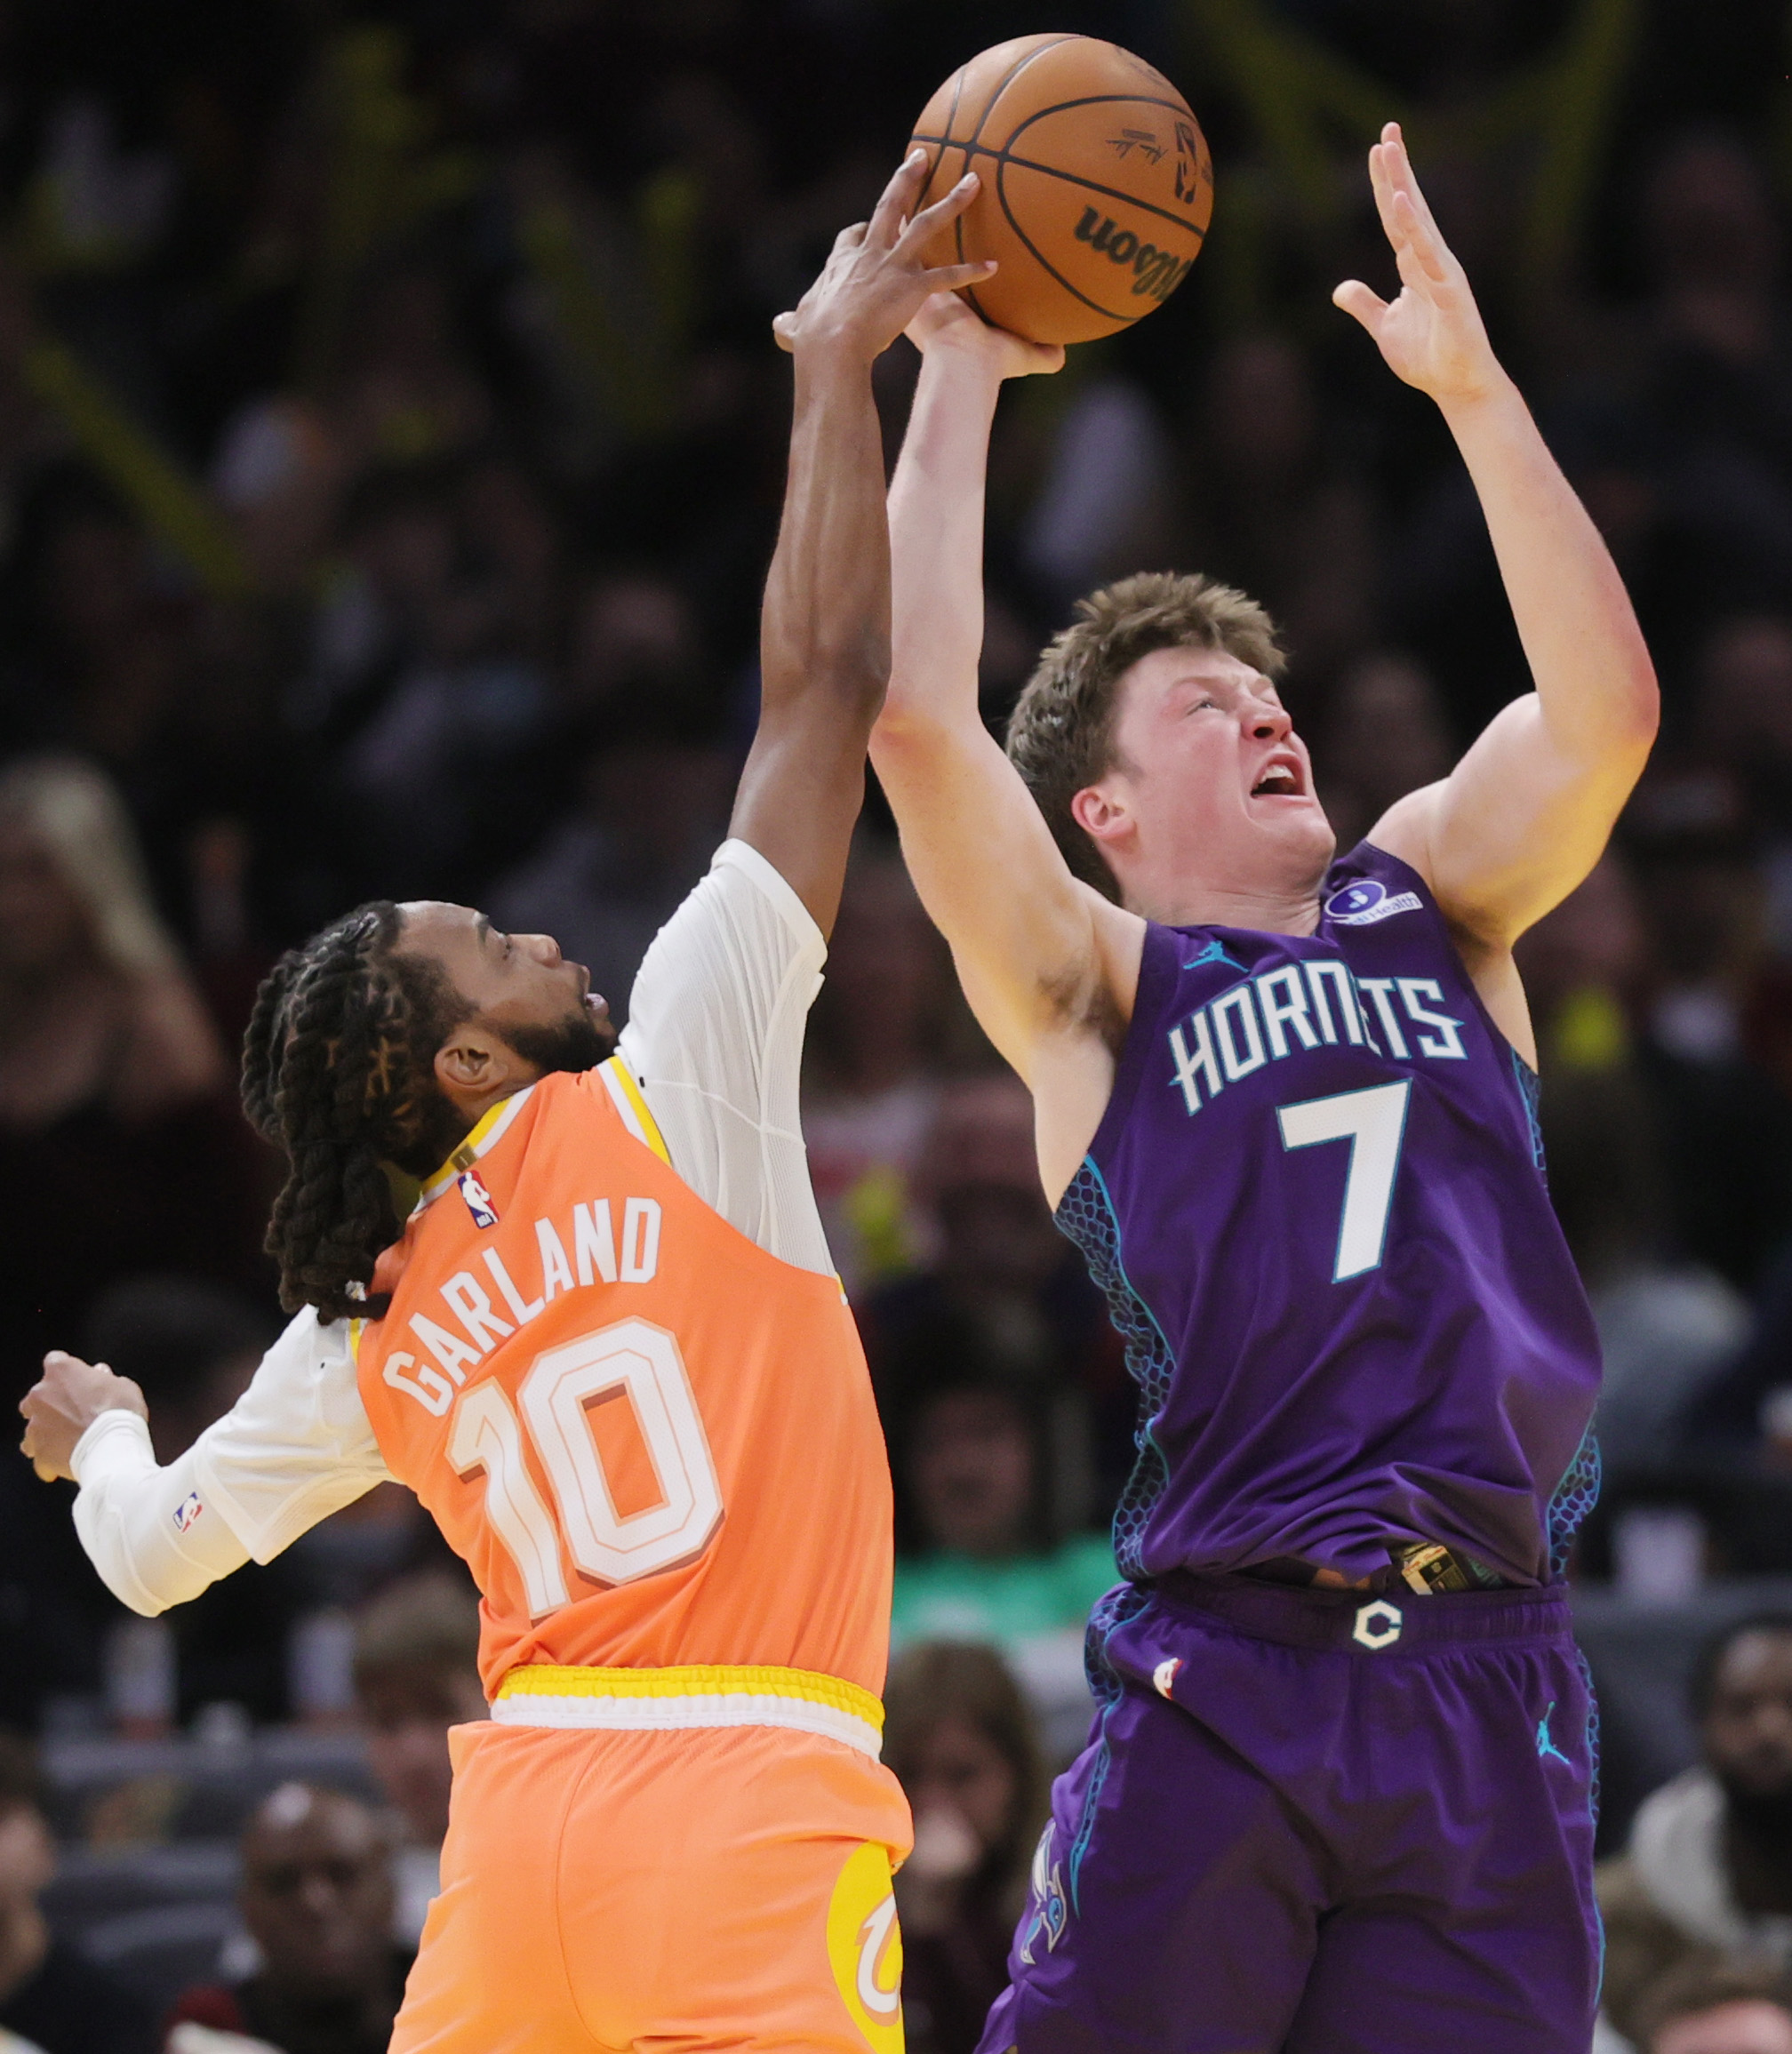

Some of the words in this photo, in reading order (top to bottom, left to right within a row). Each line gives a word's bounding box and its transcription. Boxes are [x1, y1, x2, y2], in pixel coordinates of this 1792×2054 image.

[1368, 894, 1420, 919] Health
[1168, 959, 1468, 1117] HORNTS
[1276, 1077, 1412, 1284] 7
[382, 1196, 662, 1417] GARLAND
[444, 1315, 727, 1628] 10
